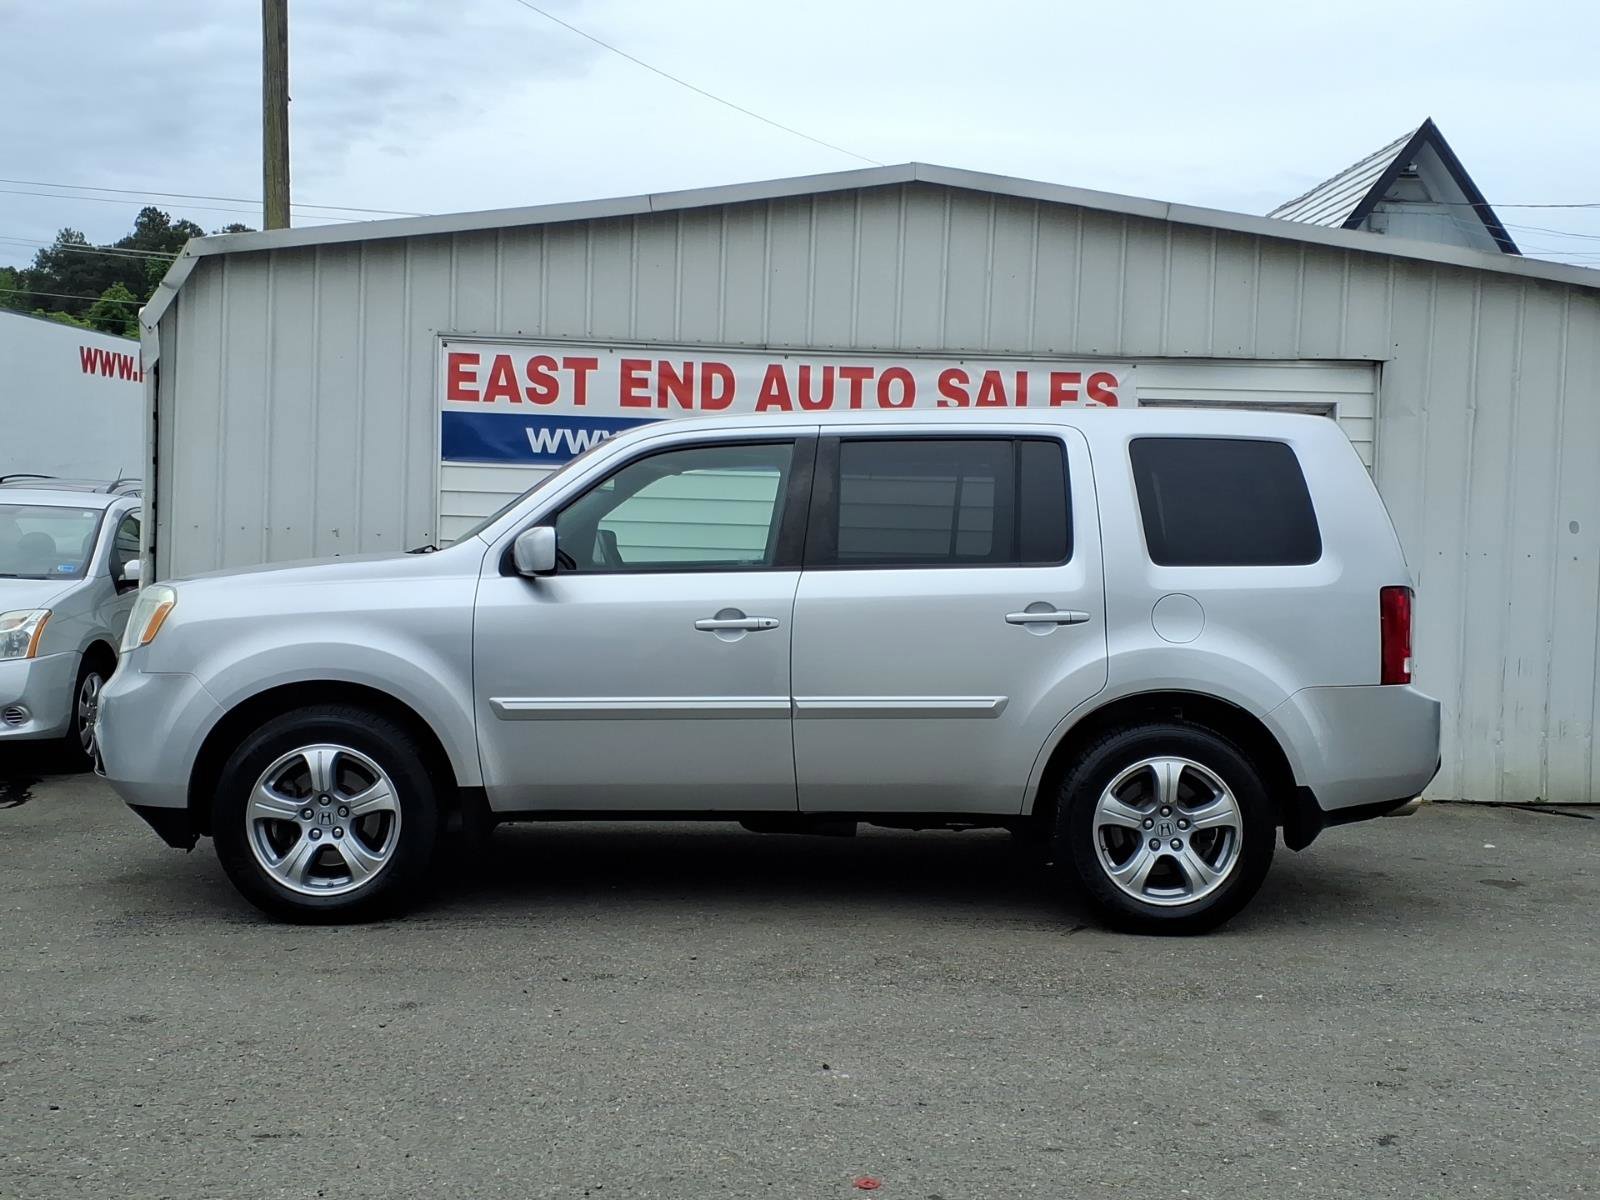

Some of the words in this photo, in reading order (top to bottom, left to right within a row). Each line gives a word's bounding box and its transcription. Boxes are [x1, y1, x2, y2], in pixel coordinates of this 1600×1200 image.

[447, 352, 598, 405] EAST
[619, 358, 735, 411] END
[755, 364, 916, 411] AUTO
